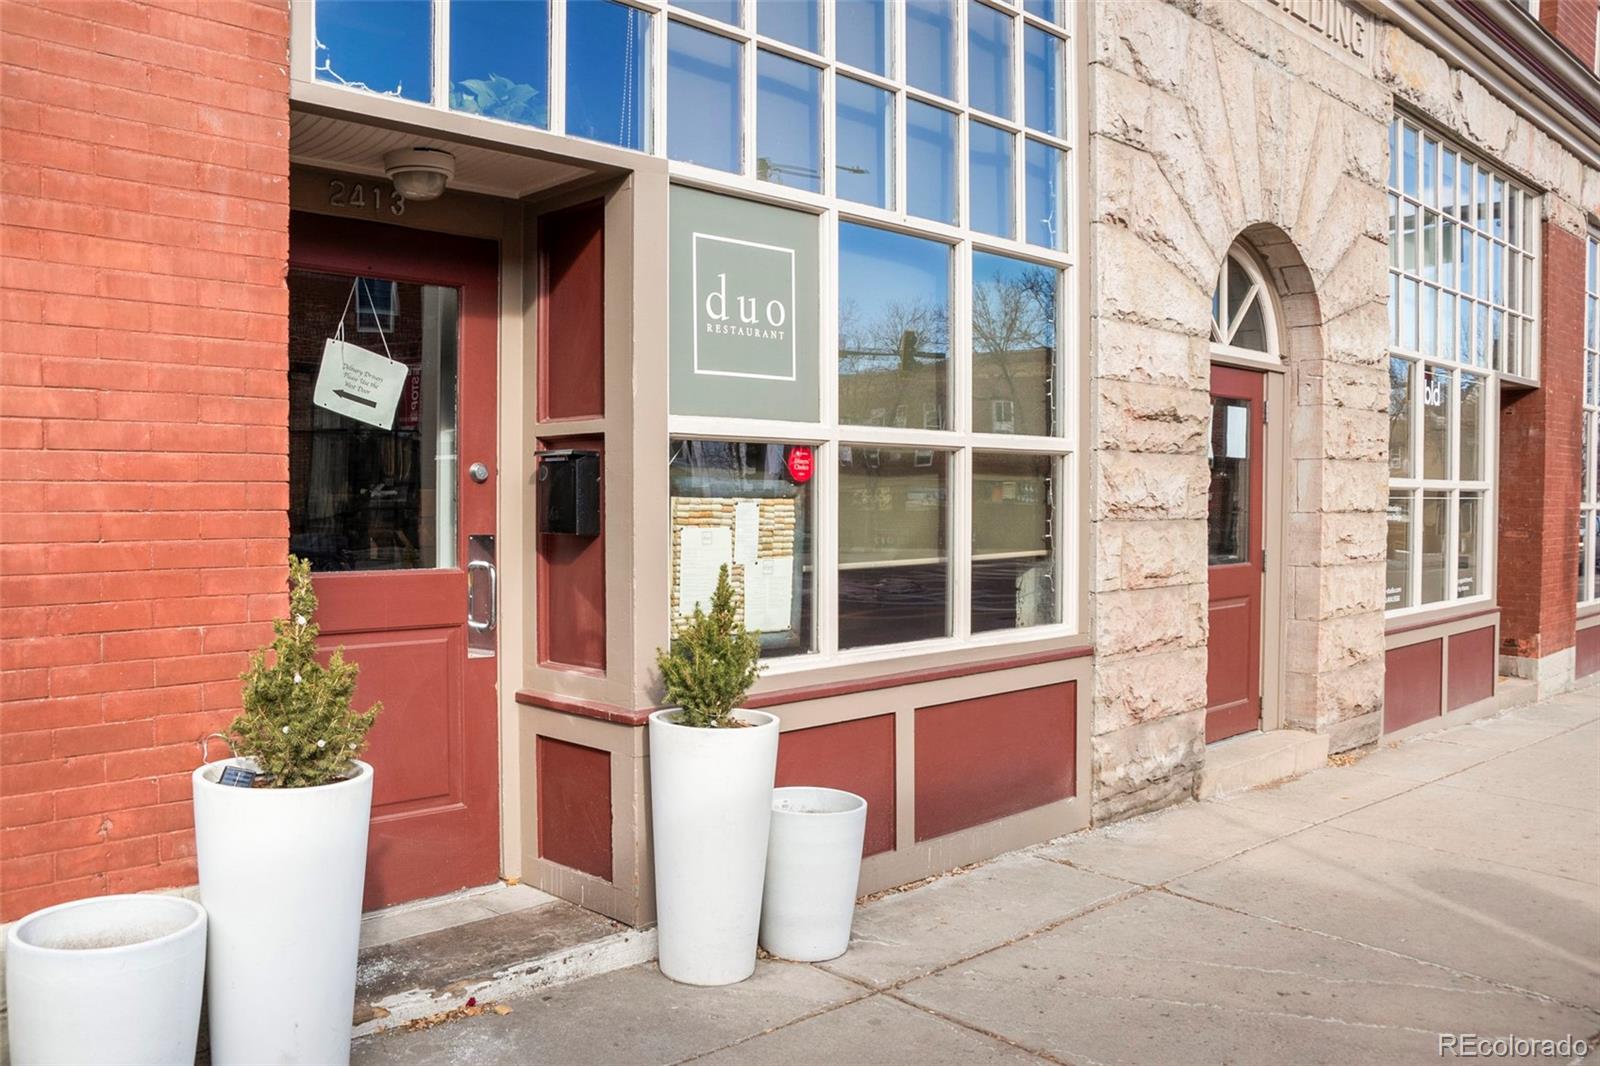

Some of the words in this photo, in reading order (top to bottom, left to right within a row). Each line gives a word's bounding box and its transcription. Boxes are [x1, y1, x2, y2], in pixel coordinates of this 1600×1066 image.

[330, 180, 405, 216] 2413
[705, 273, 786, 327] duo
[706, 323, 785, 341] RESTAURANT
[1424, 379, 1441, 407] bld
